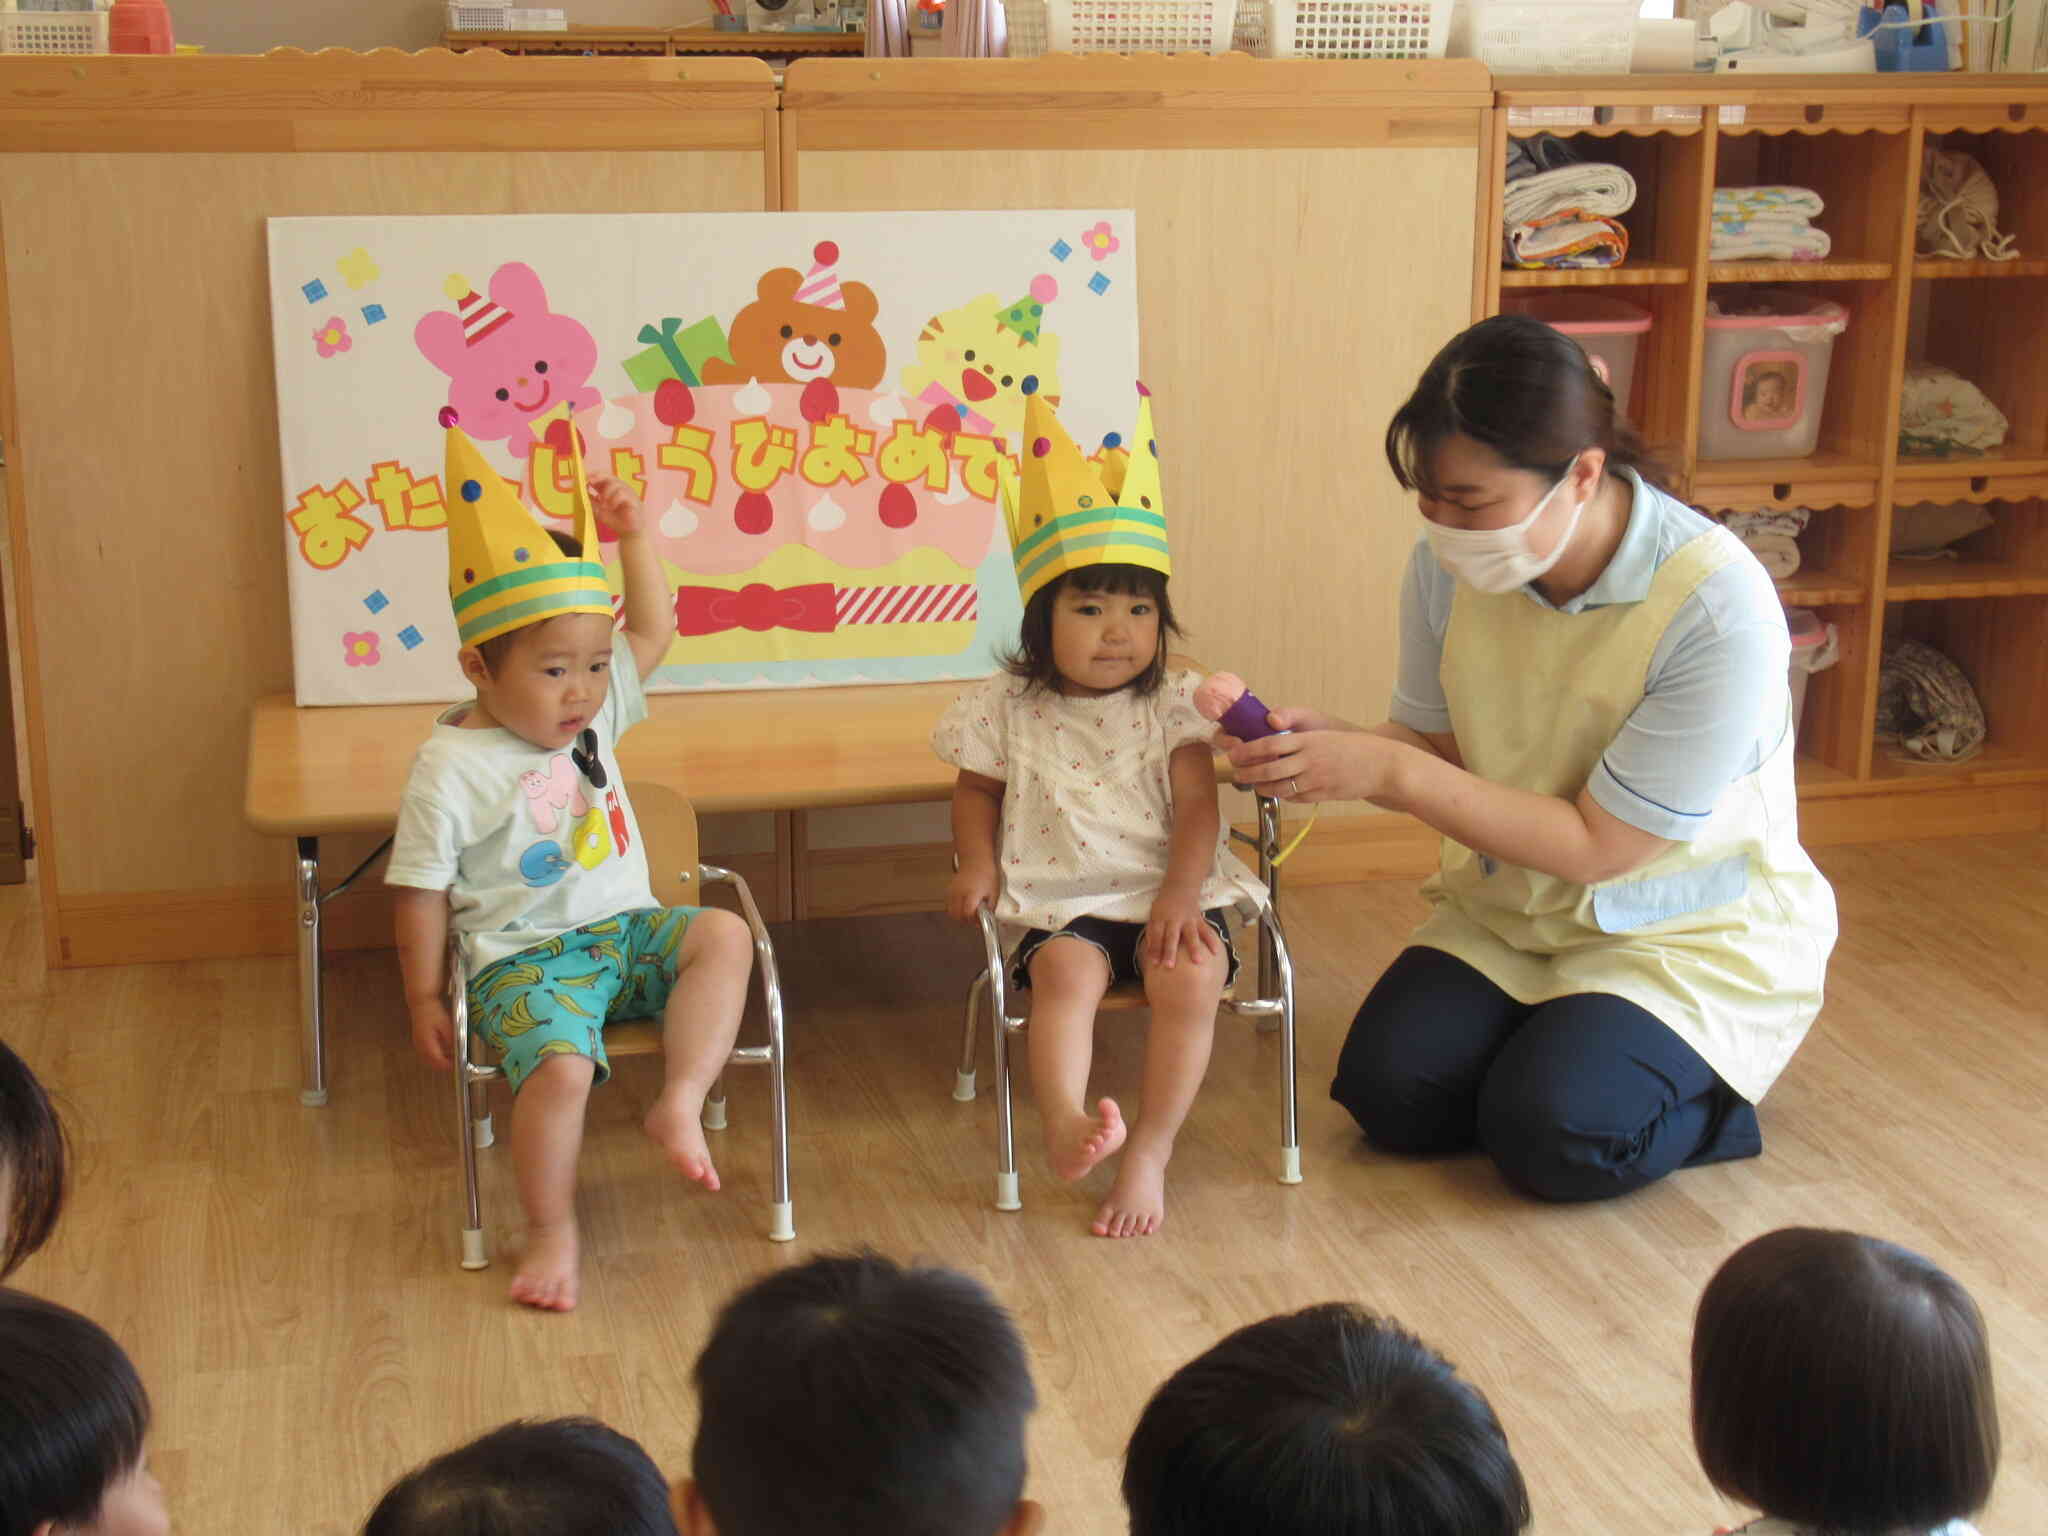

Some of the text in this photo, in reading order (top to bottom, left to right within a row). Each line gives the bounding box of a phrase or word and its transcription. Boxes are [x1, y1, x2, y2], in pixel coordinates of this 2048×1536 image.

[286, 413, 1131, 571] おたじうびおめで
